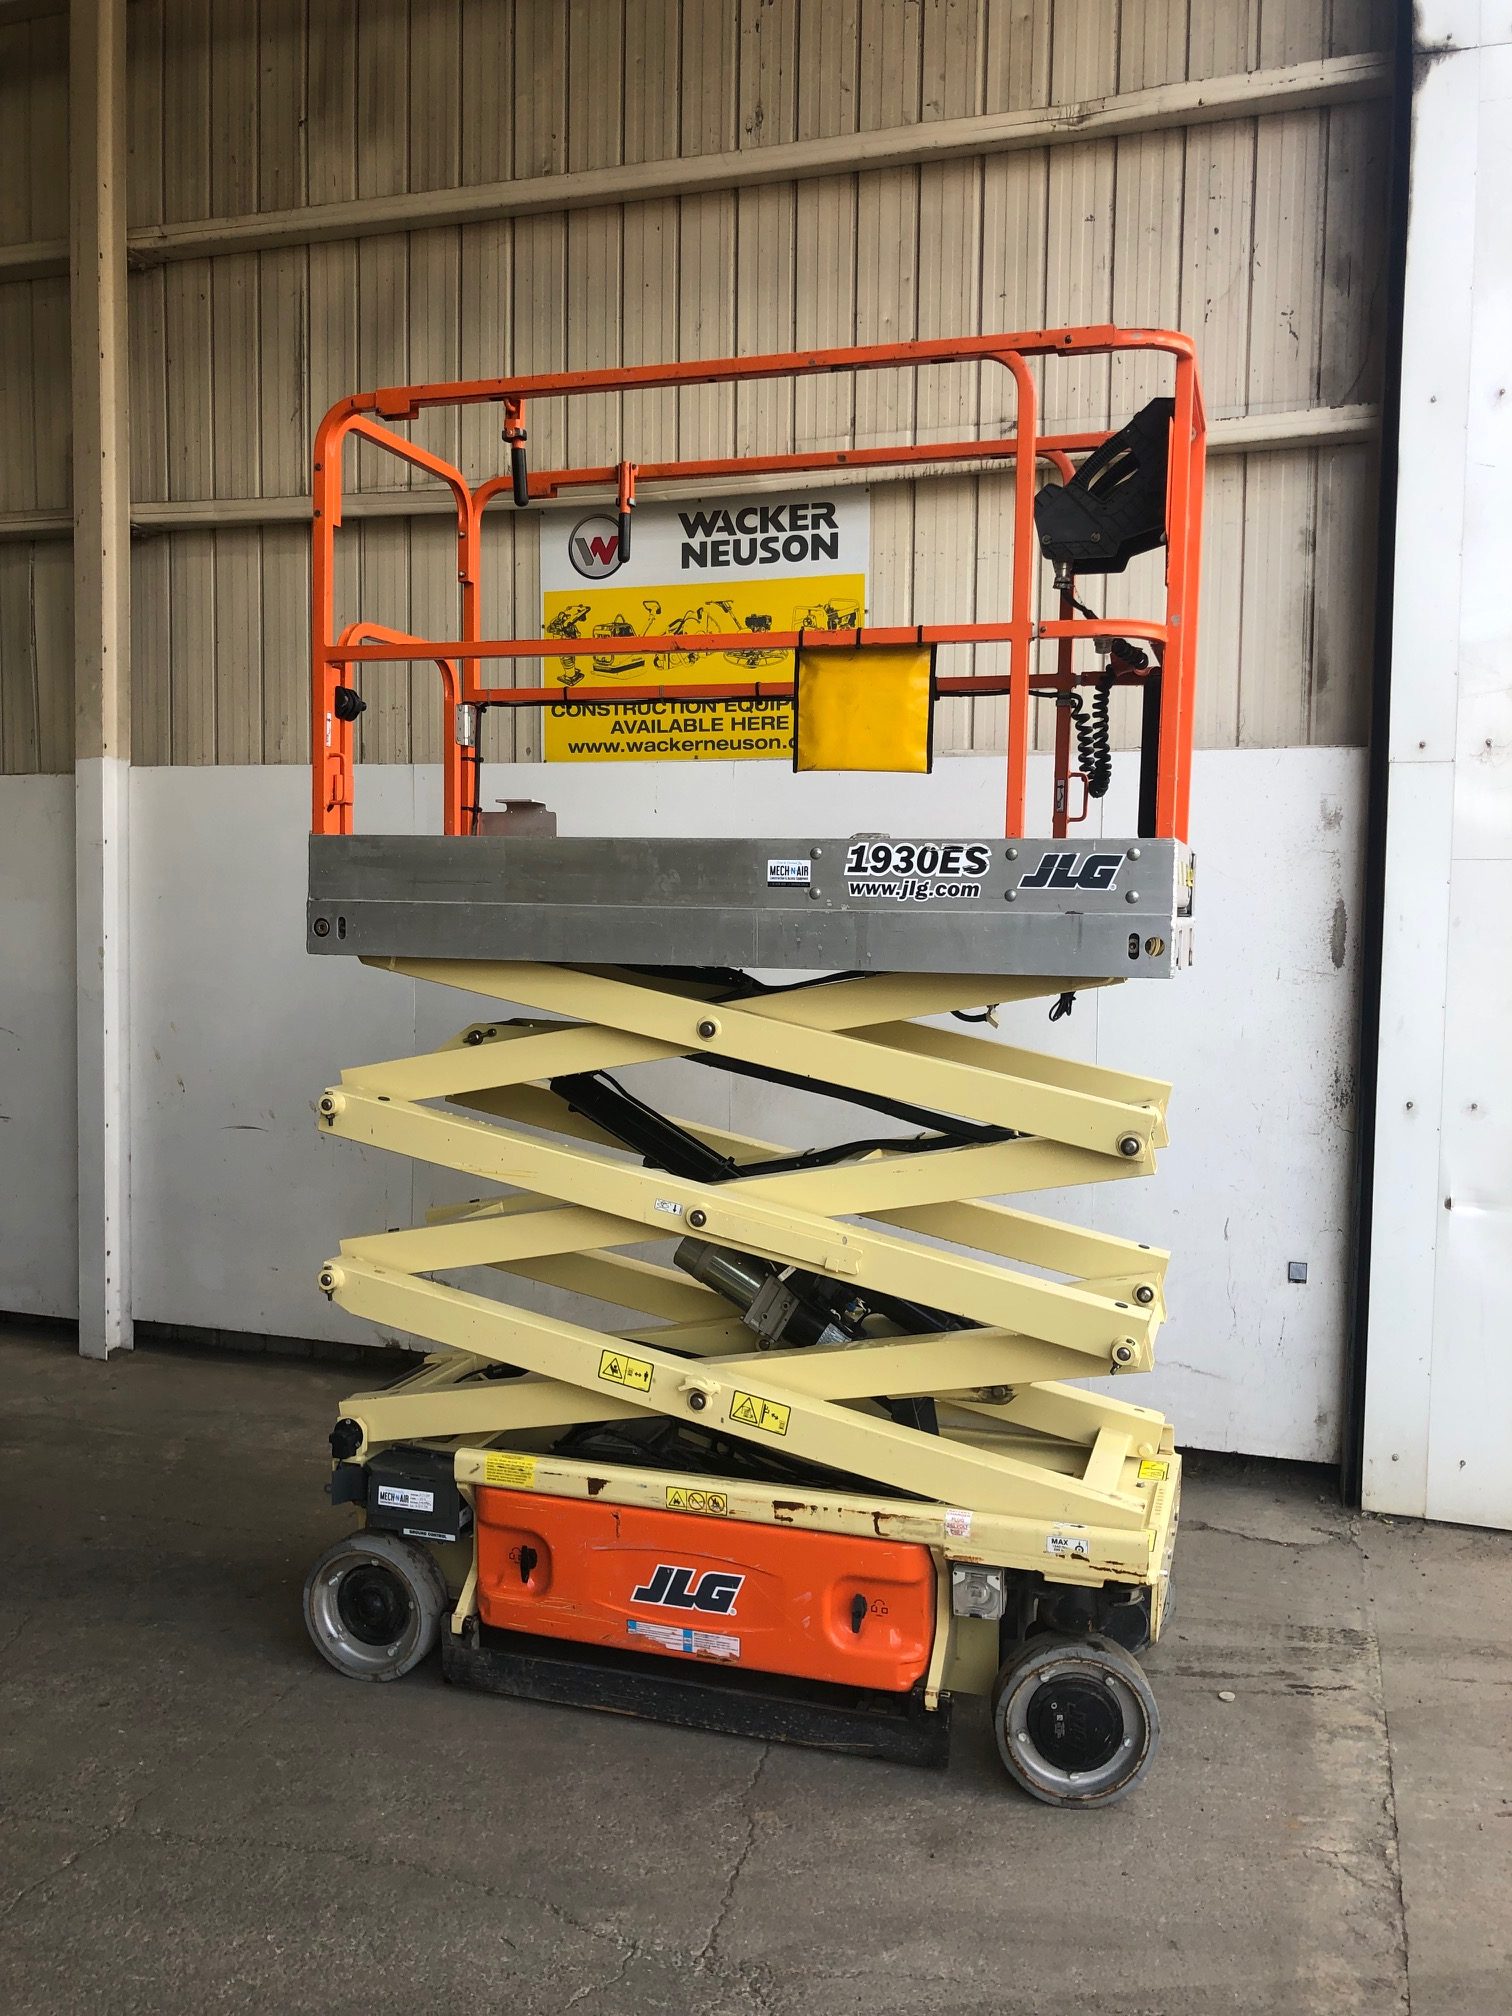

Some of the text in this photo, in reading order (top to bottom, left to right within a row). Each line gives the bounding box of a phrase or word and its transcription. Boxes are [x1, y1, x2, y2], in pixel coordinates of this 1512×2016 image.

[677, 501, 839, 538] WACKER
[681, 532, 838, 569] NEUSON
[551, 700, 795, 717] CONSTRUCTION EQUIP
[611, 716, 790, 734] AVAILABLE HERE
[848, 844, 990, 874] 1930ES
[770, 865, 790, 876] MECH
[796, 865, 809, 876] AIR
[1018, 852, 1126, 889] JLG
[850, 881, 979, 898] www.jlg.com
[380, 1491, 395, 1501] MECH
[1051, 1538, 1069, 1546] MAX
[631, 1564, 745, 1615] JLG
